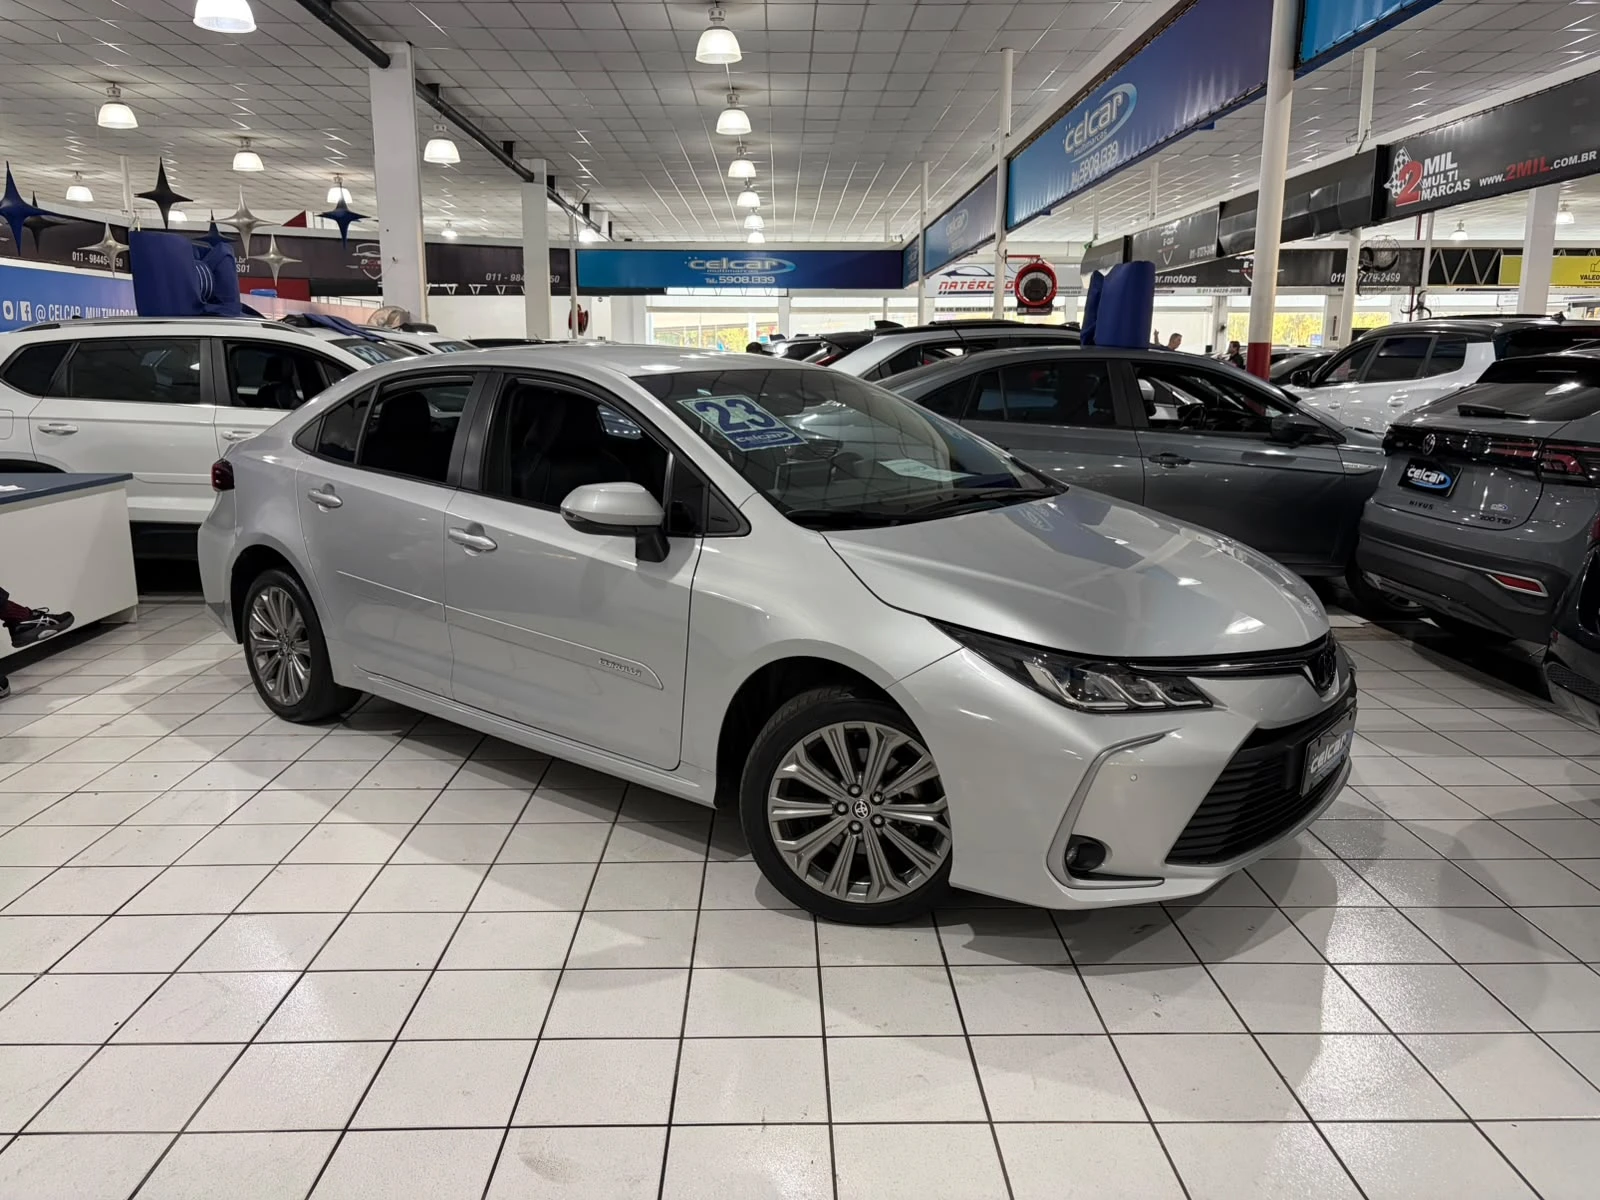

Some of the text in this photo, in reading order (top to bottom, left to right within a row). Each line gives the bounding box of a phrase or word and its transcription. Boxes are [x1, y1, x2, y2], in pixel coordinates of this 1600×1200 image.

[1065, 93, 1123, 154] celcar
[1396, 152, 1458, 207] 2 MIL
[1423, 170, 1458, 189] MULTI
[1421, 179, 1471, 201] MARCAS
[689, 257, 779, 270] celcar
[719, 276, 776, 284] 5908.1339
[939, 279, 1014, 290] NATÉRCO
[1155, 274, 1197, 284] ar.motors
[695, 399, 776, 433] 23
[736, 432, 789, 442] celcar
[1407, 467, 1445, 484] celcar
[1409, 500, 1434, 510] NIVUS
[1310, 733, 1347, 774] celcar
